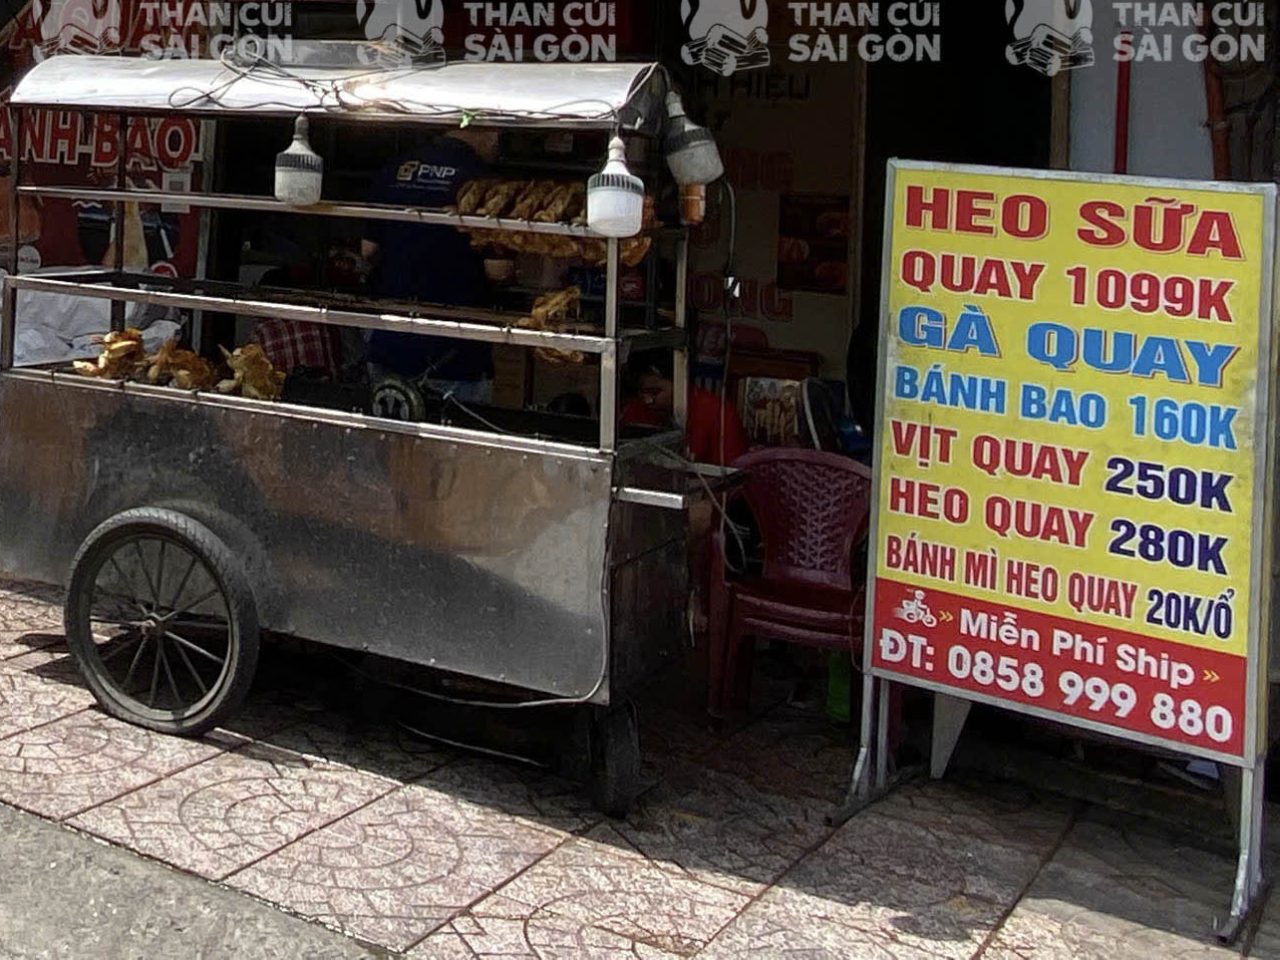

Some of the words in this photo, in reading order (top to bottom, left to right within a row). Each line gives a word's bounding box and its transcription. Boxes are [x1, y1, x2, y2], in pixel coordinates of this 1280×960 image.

[91, 106, 204, 172] BAO
[905, 184, 1051, 240] HEO
[1077, 197, 1245, 261] SỮA
[901, 249, 1046, 302] QUAY
[1067, 266, 1235, 324] 1099K
[898, 304, 1001, 358] GÀ
[1027, 321, 1240, 388] QUAY
[894, 363, 1007, 416] BÁNH
[1021, 384, 1107, 430] BAO
[1130, 394, 1239, 451] 160K
[890, 419, 958, 470] VỊT
[972, 433, 1090, 488] QUAY
[1106, 456, 1235, 514] 250K
[890, 477, 970, 526] HEO
[985, 496, 1095, 549] QUAY
[1108, 517, 1229, 577] 280K
[885, 534, 956, 582] BÁNH
[964, 548, 998, 591] MÌ
[1006, 559, 1058, 604] HEO
[1068, 571, 1138, 620] QUAY
[1146, 585, 1235, 642] 20K/Ổ
[879, 627, 935, 673] ĐT:
[947, 642, 1044, 698] 0858
[1059, 671, 1137, 719] 999
[1150, 692, 1233, 744] 880
[959, 606, 1040, 654] Miễn
[1052, 627, 1104, 666] Phí
[1116, 643, 1196, 692] Ship
